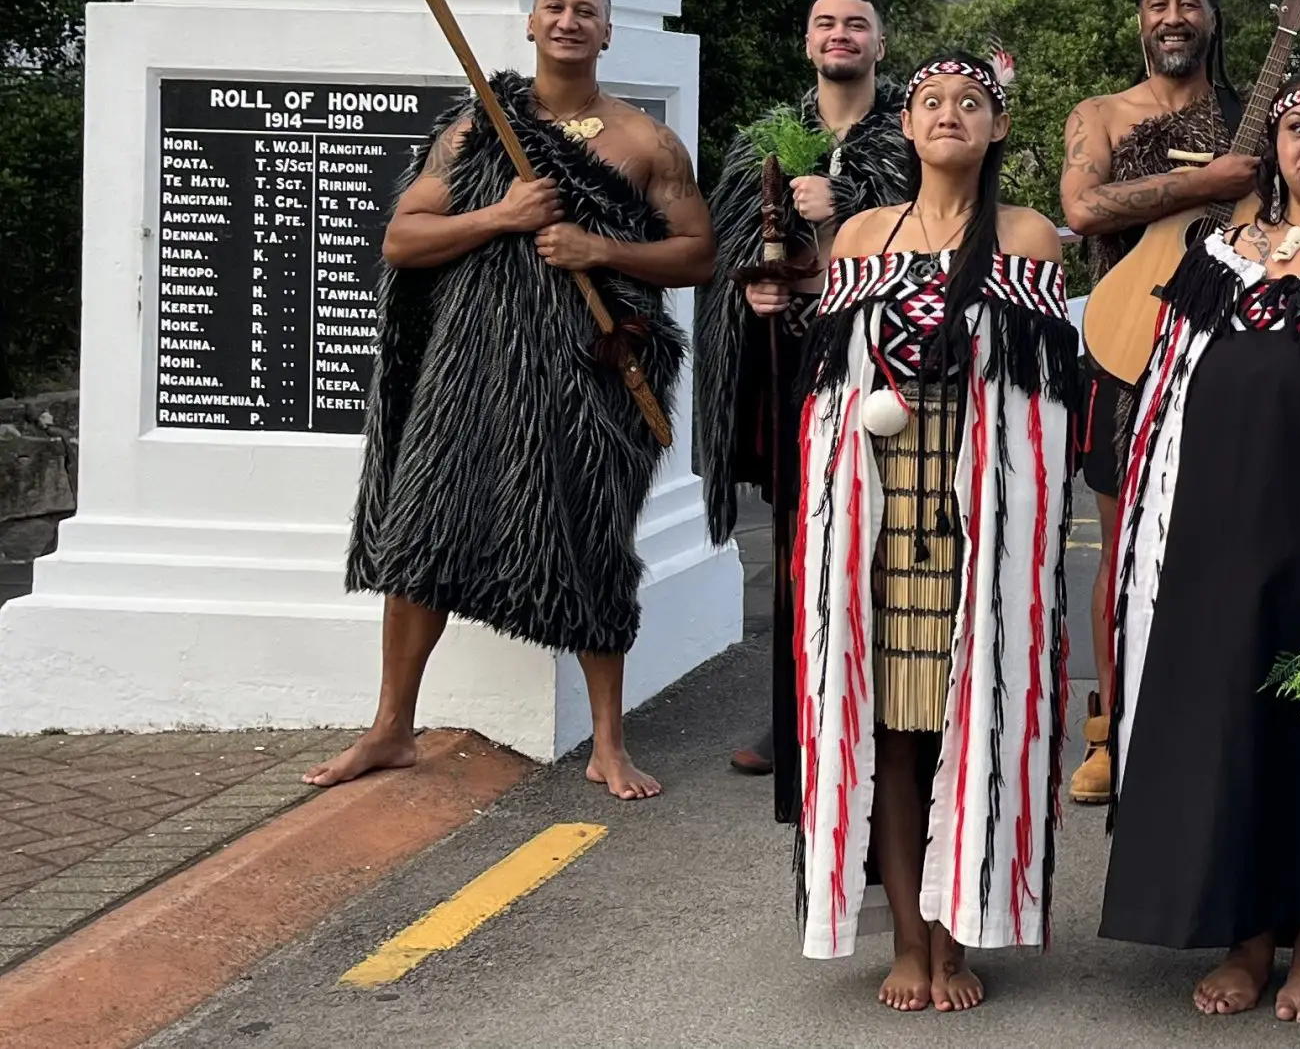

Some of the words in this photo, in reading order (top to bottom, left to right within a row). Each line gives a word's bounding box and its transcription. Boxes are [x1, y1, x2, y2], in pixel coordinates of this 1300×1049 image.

[211, 89, 272, 108] ROLL
[285, 91, 314, 109] OF
[328, 92, 418, 113] HONOUR
